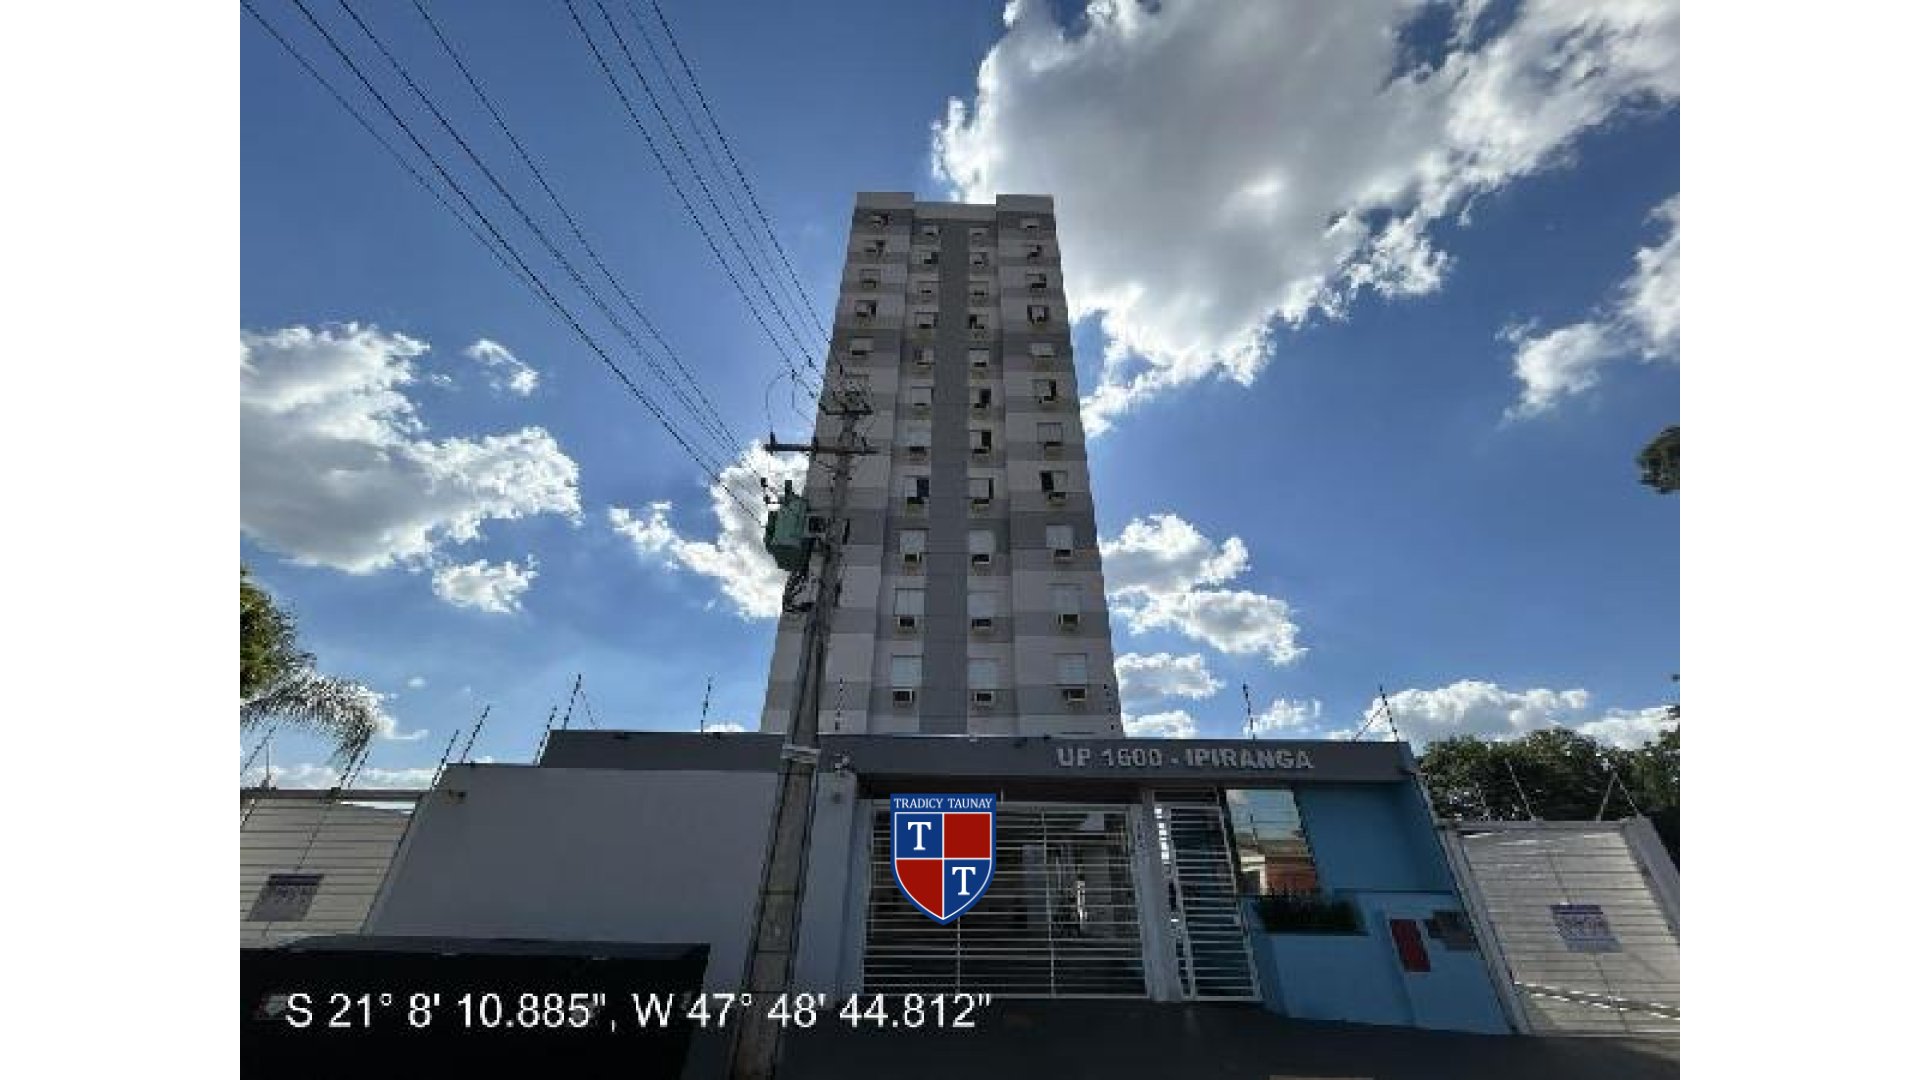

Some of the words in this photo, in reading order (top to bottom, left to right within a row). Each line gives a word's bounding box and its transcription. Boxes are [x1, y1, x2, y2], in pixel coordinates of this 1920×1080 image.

[1056, 748, 1091, 767] UP
[1101, 749, 1163, 767] 1600
[1186, 749, 1314, 769] IPIRANGA
